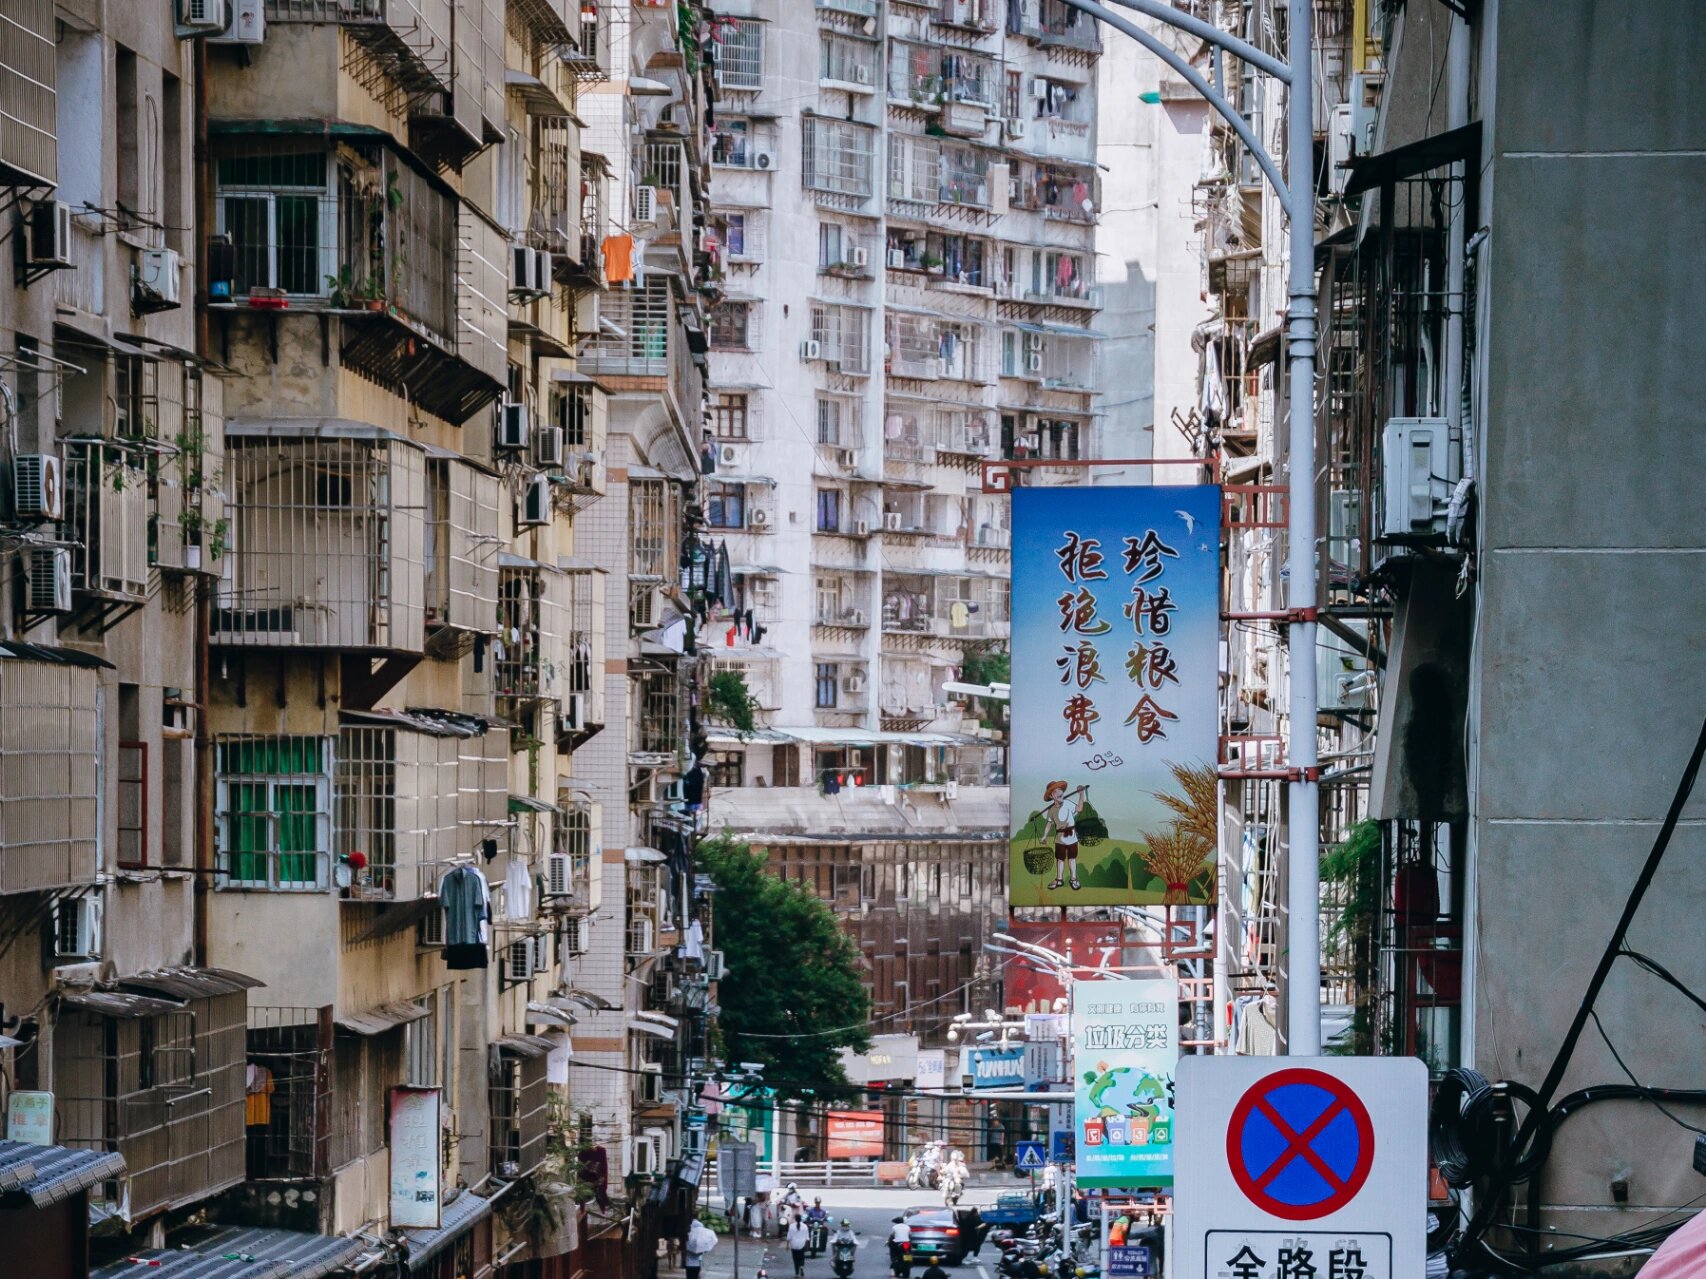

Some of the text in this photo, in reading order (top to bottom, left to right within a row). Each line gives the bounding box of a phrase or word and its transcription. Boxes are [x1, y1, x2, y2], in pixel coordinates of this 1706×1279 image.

[1055, 531, 1112, 744] 拒绝浪费
[1121, 529, 1180, 745] 珍惜粮食
[1085, 1024, 1167, 1050] 垃圾分类
